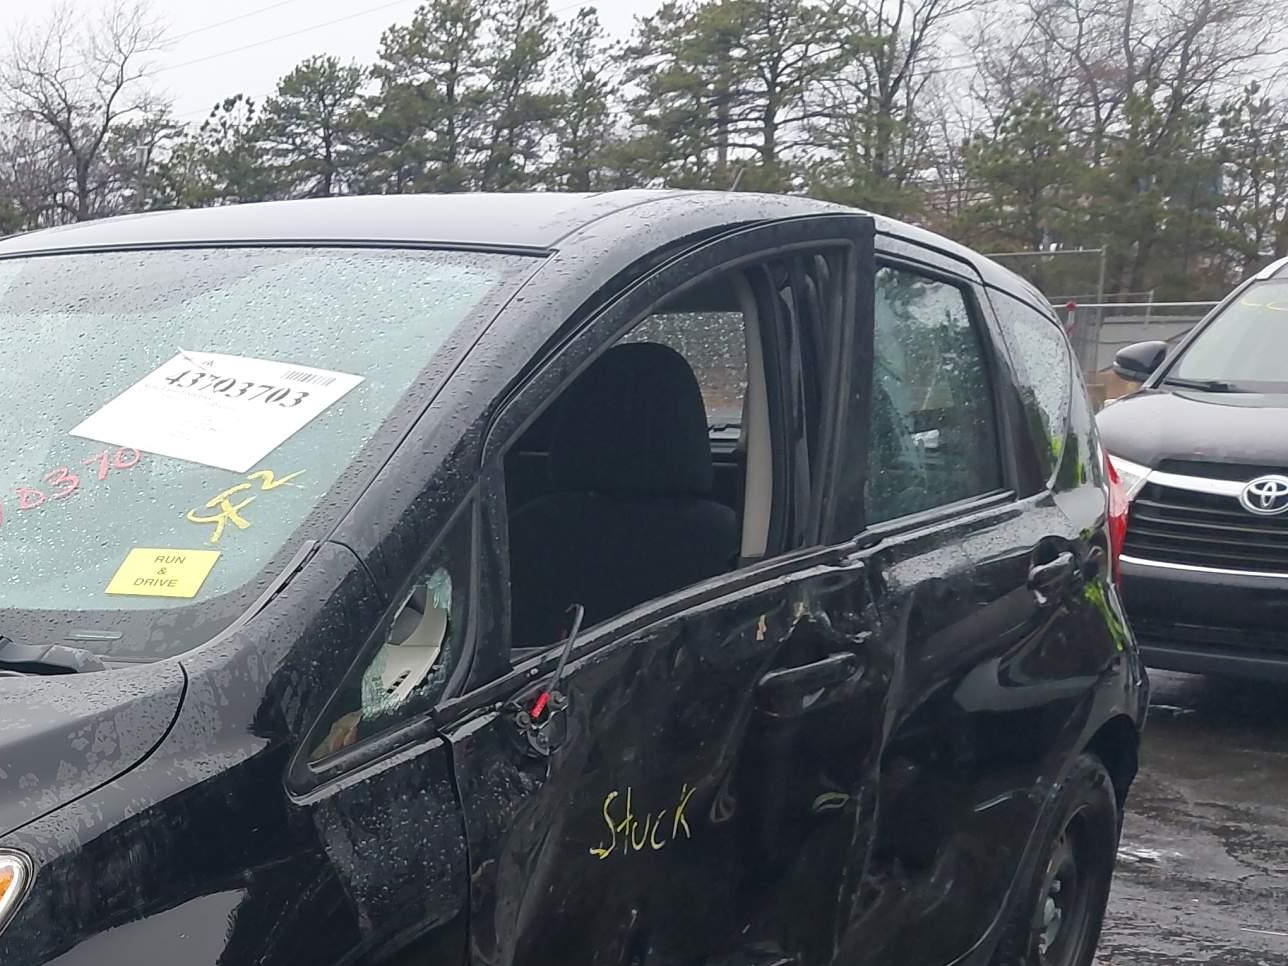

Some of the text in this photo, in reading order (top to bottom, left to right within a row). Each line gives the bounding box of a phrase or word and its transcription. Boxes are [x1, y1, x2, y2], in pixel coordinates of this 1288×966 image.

[165, 369, 310, 408] 43703703
[154, 555, 186, 564] RUN
[157, 567, 167, 575] &
[133, 578, 178, 587] DRIVE
